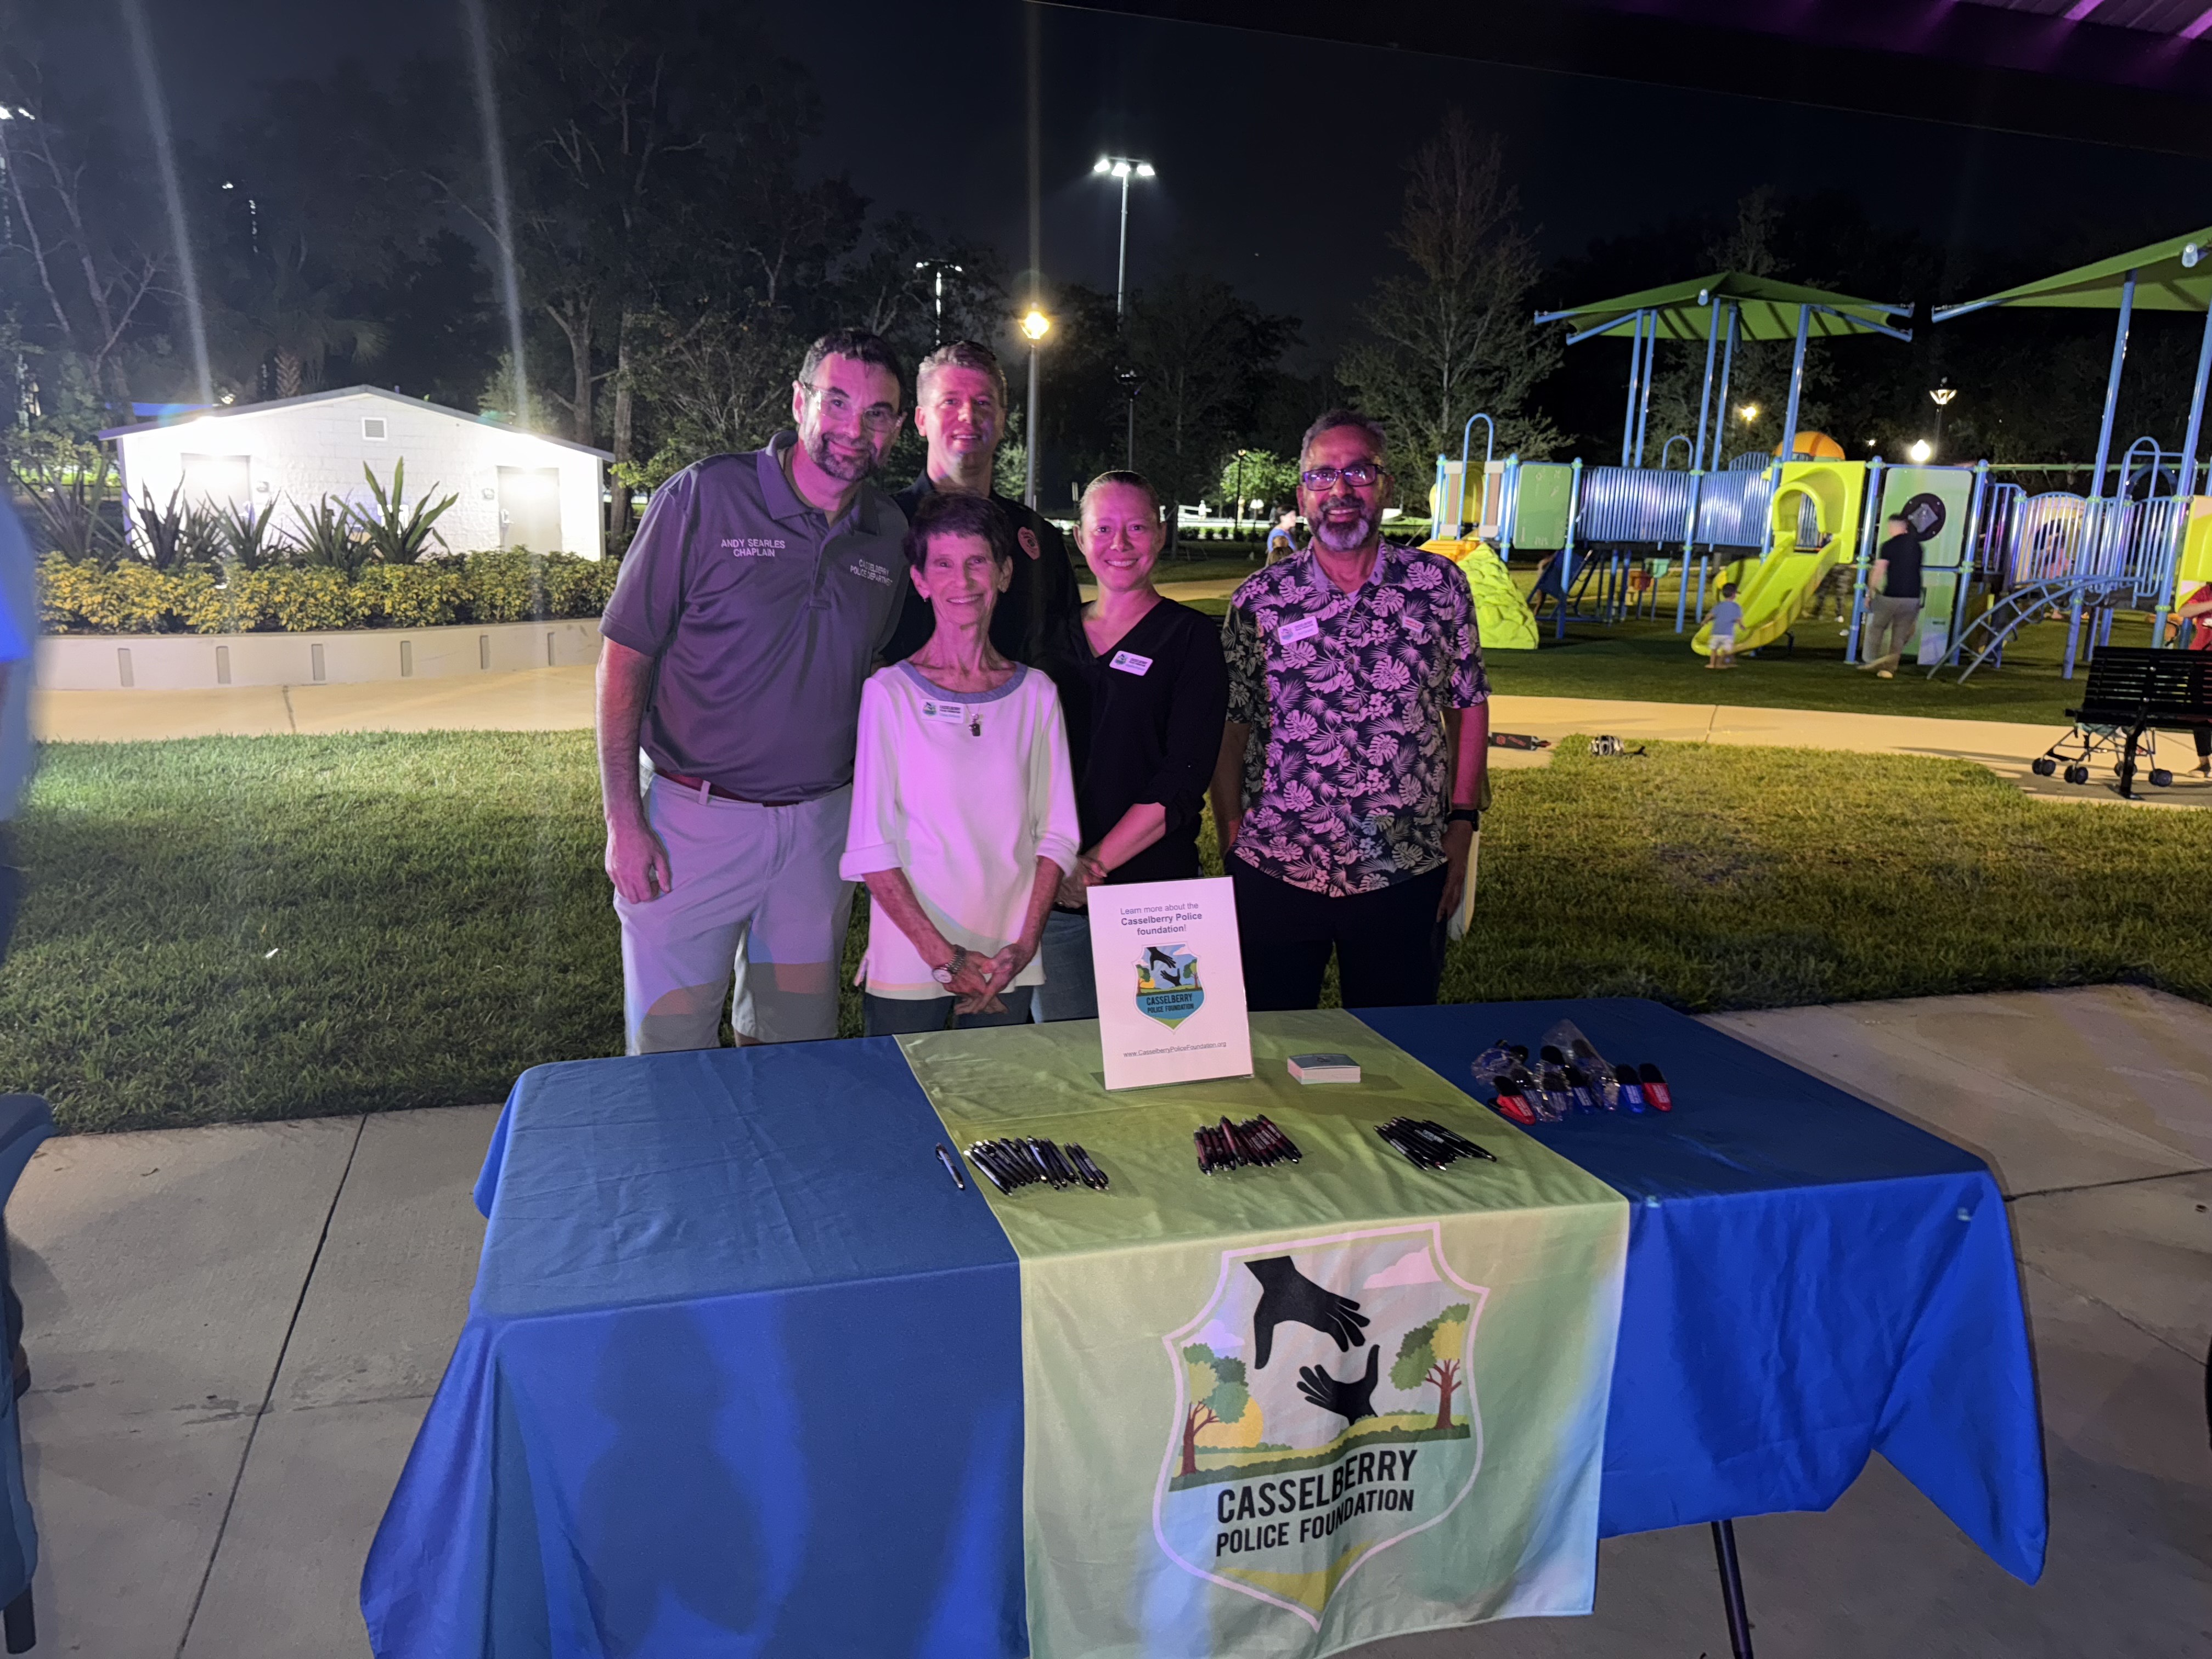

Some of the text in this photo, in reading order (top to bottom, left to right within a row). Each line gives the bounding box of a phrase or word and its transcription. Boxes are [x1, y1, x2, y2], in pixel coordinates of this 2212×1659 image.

[721, 538, 786, 549] ANDY SEARLES
[733, 548, 775, 557] CHAPLAIN
[850, 565, 867, 578] POLICE
[1121, 912, 1203, 926] Casselberry Police
[1137, 924, 1187, 935] foundation!
[1146, 993, 1192, 1006] CASSELBERRY
[1165, 1003, 1194, 1012] FOUNDATION
[1123, 1042, 1226, 1058] www.CasselberryPoliceFoundation.org
[1217, 1449, 1418, 1524] CASSELBERRY
[1216, 1489, 1414, 1557] POLICE FOUNDATION
